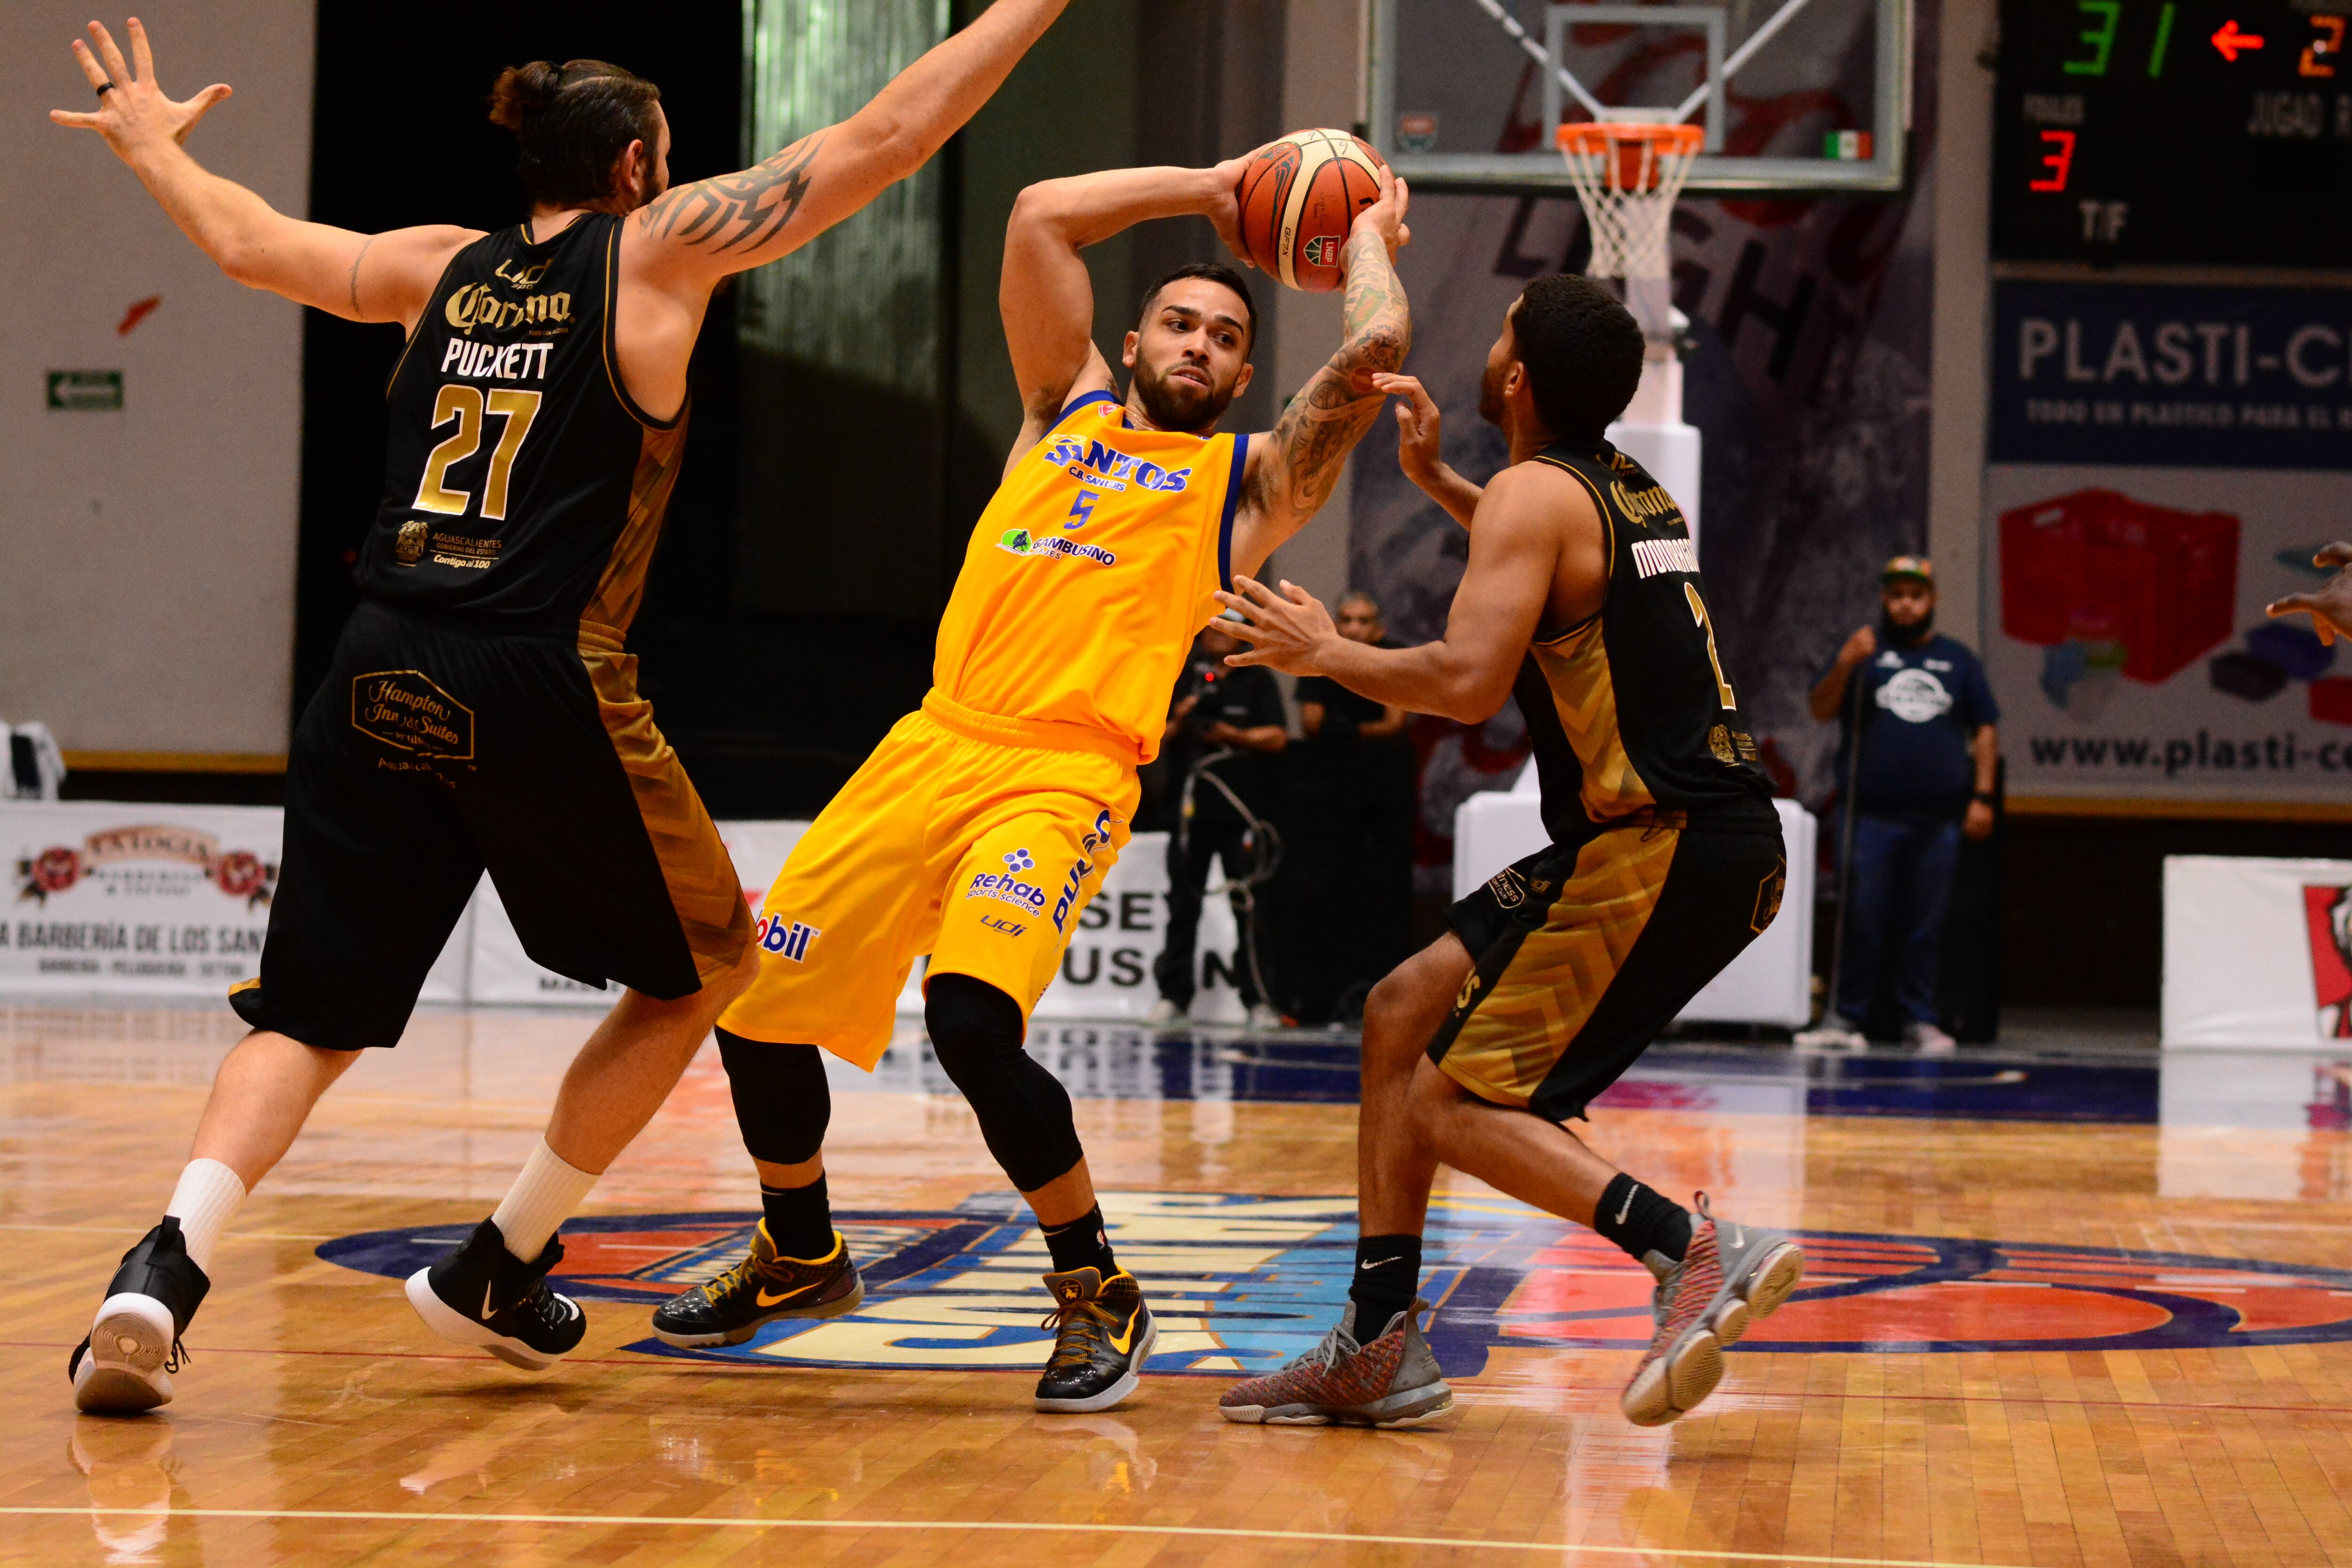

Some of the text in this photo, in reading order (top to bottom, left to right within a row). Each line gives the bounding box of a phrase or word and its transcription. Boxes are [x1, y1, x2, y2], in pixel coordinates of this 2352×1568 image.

[2029, 130, 2077, 191] 3
[1325, 242, 1335, 263] LNBP
[441, 337, 554, 380] PUCKETT
[2019, 316, 2352, 388] PLASTI-C
[412, 384, 542, 521] 27
[1043, 438, 1192, 493] SANTOS
[1085, 474, 1106, 487] SAN
[1105, 479, 1126, 492] LUIS
[1064, 489, 1100, 530] 5
[433, 532, 502, 549] AGUASCALIENTES
[437, 542, 465, 552] GOBIERNO
[1033, 537, 1115, 566] GAMBUSINO
[434, 554, 466, 568] Contigo
[473, 560, 491, 569] 100
[369, 680, 450, 721] Hampton
[365, 704, 406, 727] Inn
[415, 716, 459, 744] Suites
[396, 732, 405, 740] by
[969, 873, 1046, 907] Rehab
[1496, 871, 1519, 902] itness
[966, 889, 1040, 917] sports science
[135, 924, 158, 953] DE
[170, 924, 207, 954] LOS
[756, 909, 810, 961] obil
